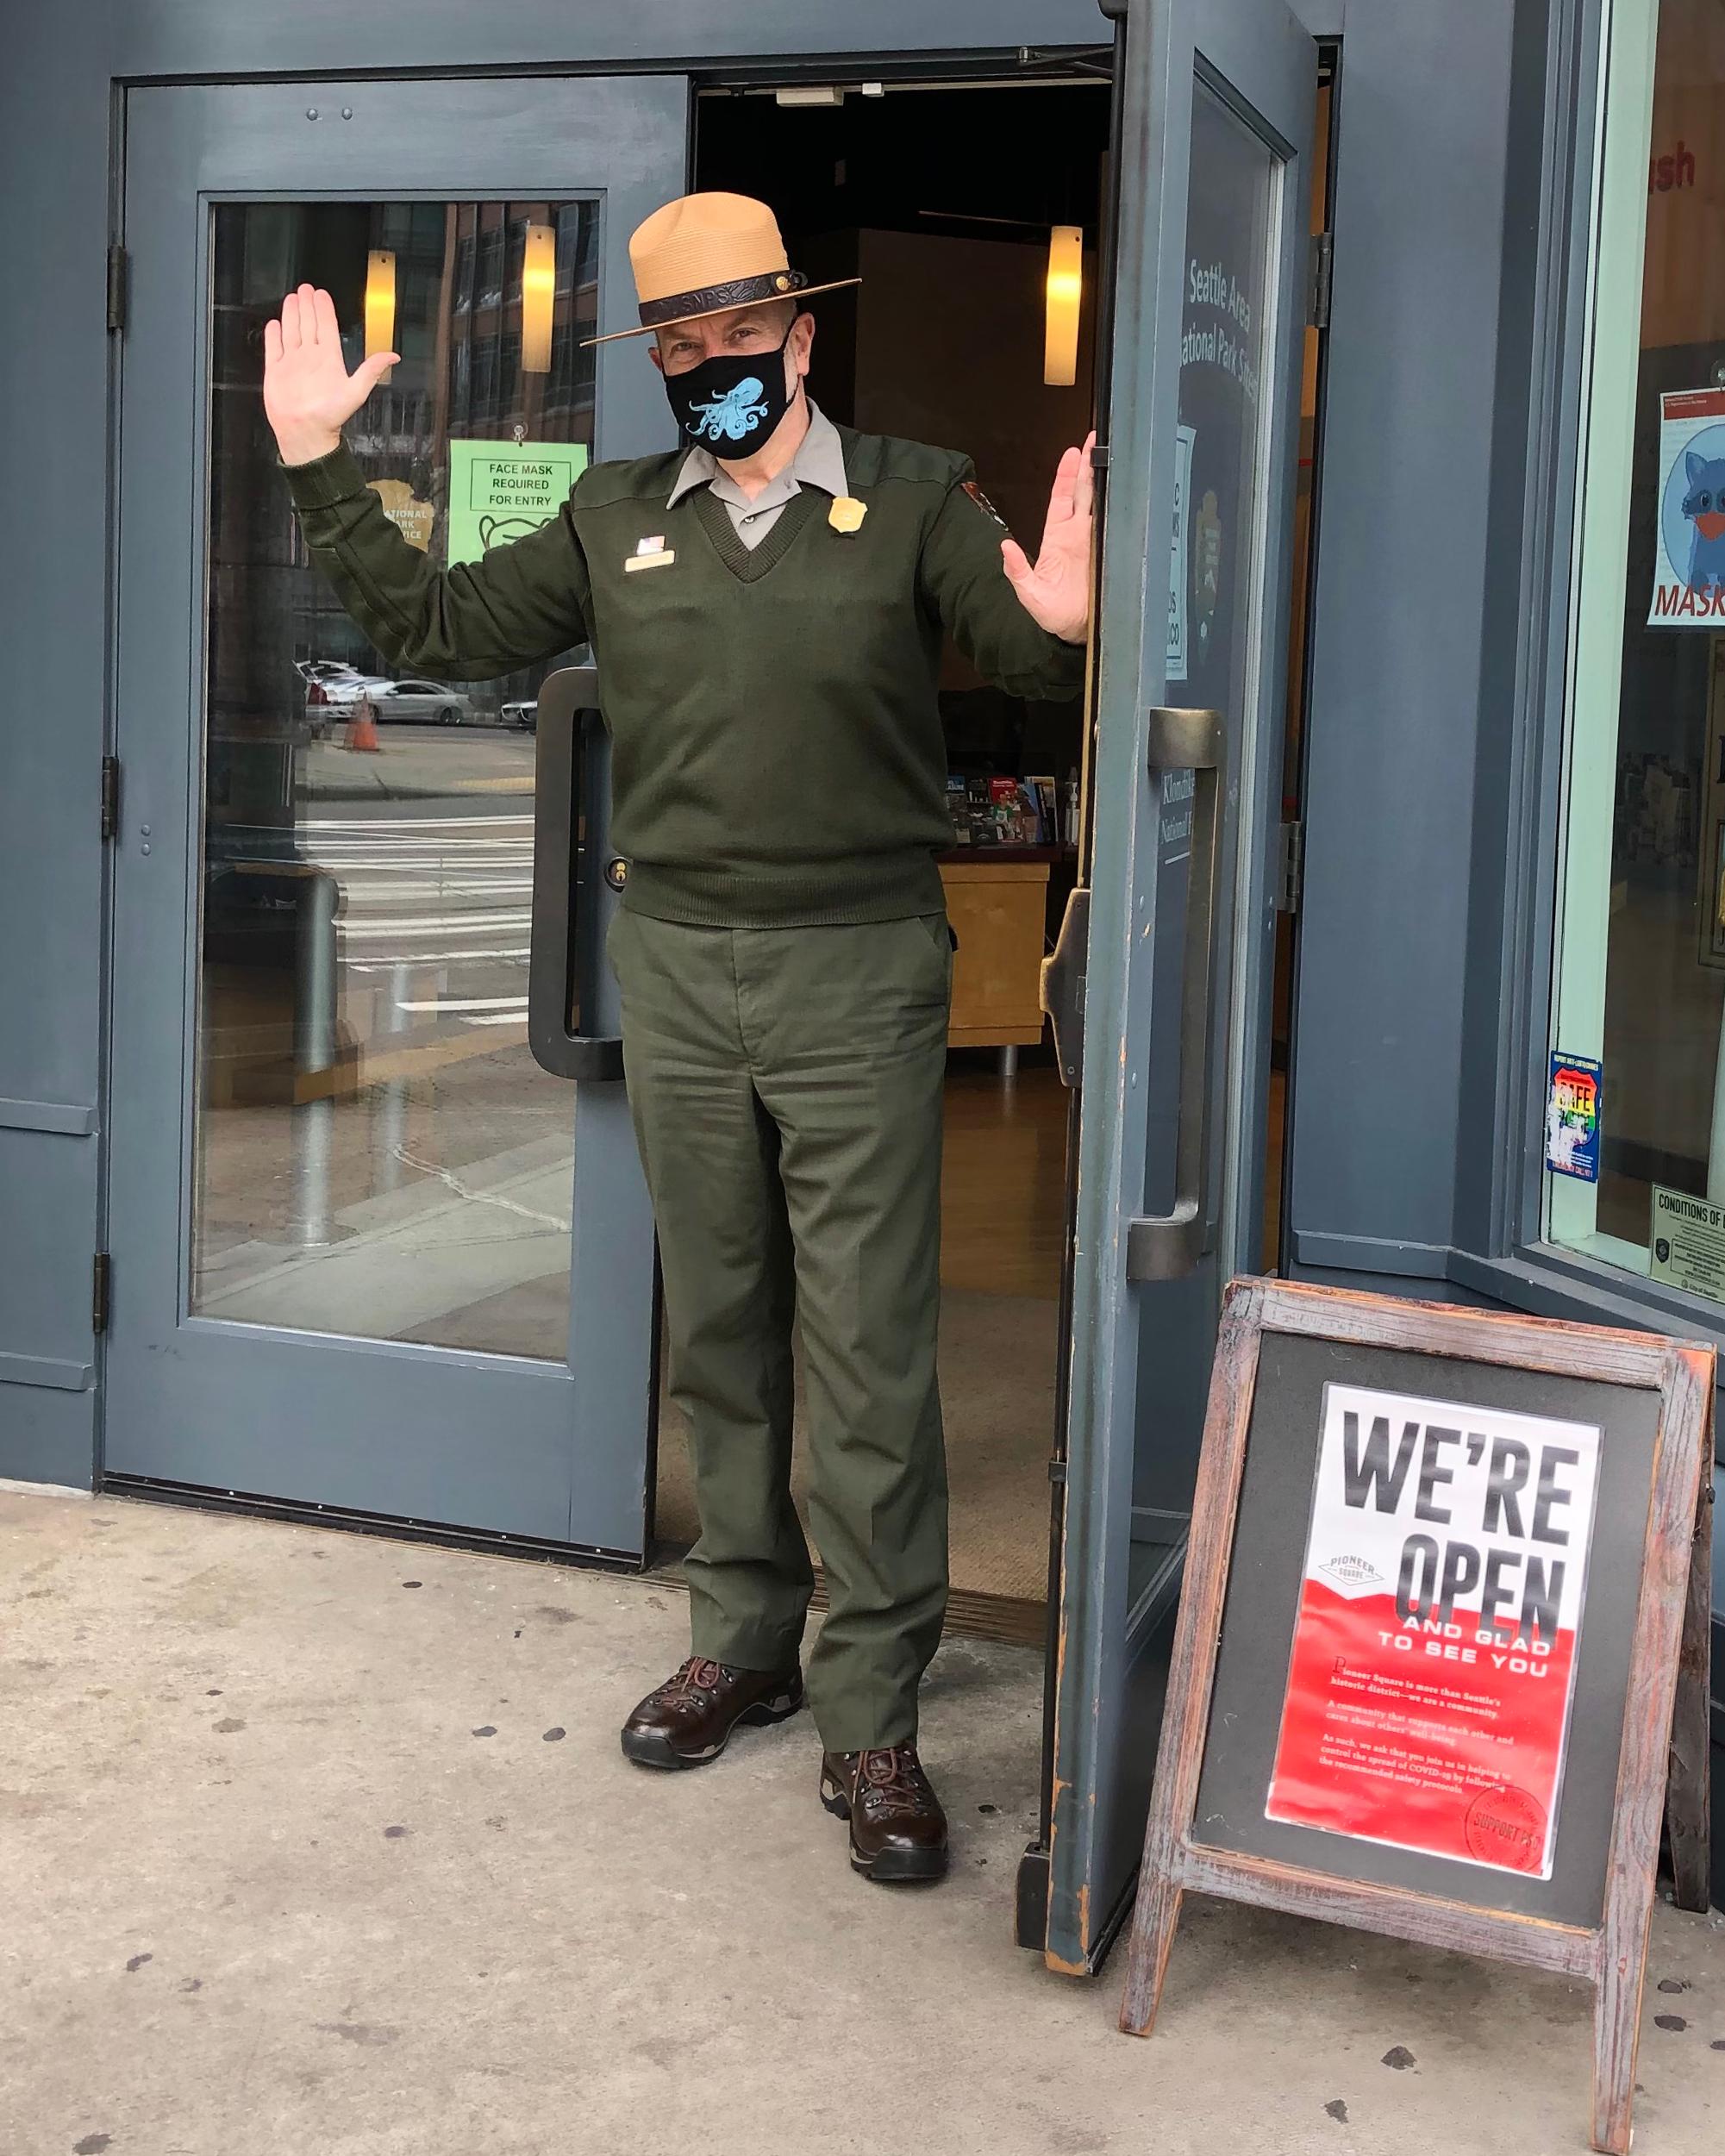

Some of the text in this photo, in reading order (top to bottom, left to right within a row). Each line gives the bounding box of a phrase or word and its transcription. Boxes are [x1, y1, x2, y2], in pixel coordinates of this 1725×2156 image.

[1190, 259, 1251, 334] Seattle Area
[1180, 322, 1216, 367] ational
[1218, 328, 1239, 376] Park
[489, 463, 553, 476] FACE MASK
[492, 478, 549, 491] REQUIRED
[383, 509, 428, 519] ATIONAL
[489, 495, 552, 507] FOR ENTRY
[397, 520, 415, 528] ARK
[402, 530, 422, 540] VICE
[1654, 584, 1725, 617] MASK
[1659, 1193, 1709, 1222] CONDITIONS
[1709, 1209, 1722, 1227] OF
[1344, 1410, 1579, 1547] WE'RE
[1330, 1555, 1375, 1576] PIONEER
[1339, 1567, 1364, 1579] SQUARE
[1395, 1534, 1566, 1650] OPEN
[1403, 1615, 1551, 1657] AND GLAD
[1378, 1631, 1548, 1678] TO SEE YOU
[1330, 1675, 1366, 1690] historic
[1422, 1697, 1437, 1706] are
[1373, 1673, 1404, 1687] Square
[1405, 1680, 1414, 1689] is
[1416, 1684, 1438, 1694] more
[1441, 1687, 1461, 1699] than
[1463, 1692, 1501, 1707] Seattle's
[1326, 1712, 1348, 1722] cares
[1351, 1715, 1376, 1728] about
[1328, 1699, 1335, 1708] A
[1337, 1703, 1386, 1720] community
[1388, 1711, 1406, 1722] that
[1497, 1734, 1514, 1746] and
[1318, 1756, 1333, 1766] the
[1334, 1761, 1394, 1778] recommended
[1395, 1774, 1421, 1786] safety
[1321, 1746, 1351, 1758] control
[1353, 1752, 1366, 1761] the
[1368, 1756, 1397, 1768] spread
[1397, 1761, 1407, 1770] of
[1409, 1764, 1452, 1780] COVID-19
[1453, 1772, 1464, 1784] by
[1322, 1734, 1334, 1742] As
[1359, 1742, 1372, 1751] we
[1372, 1744, 1388, 1754] ask
[1389, 1747, 1407, 1758] that
[1409, 1753, 1424, 1763] you
[1426, 1755, 1443, 1765] join
[1445, 1760, 1455, 1769] us
[1457, 1762, 1466, 1771] in
[1467, 1764, 1499, 1780] helping
[1473, 1812, 1520, 1842] SUPPORT
